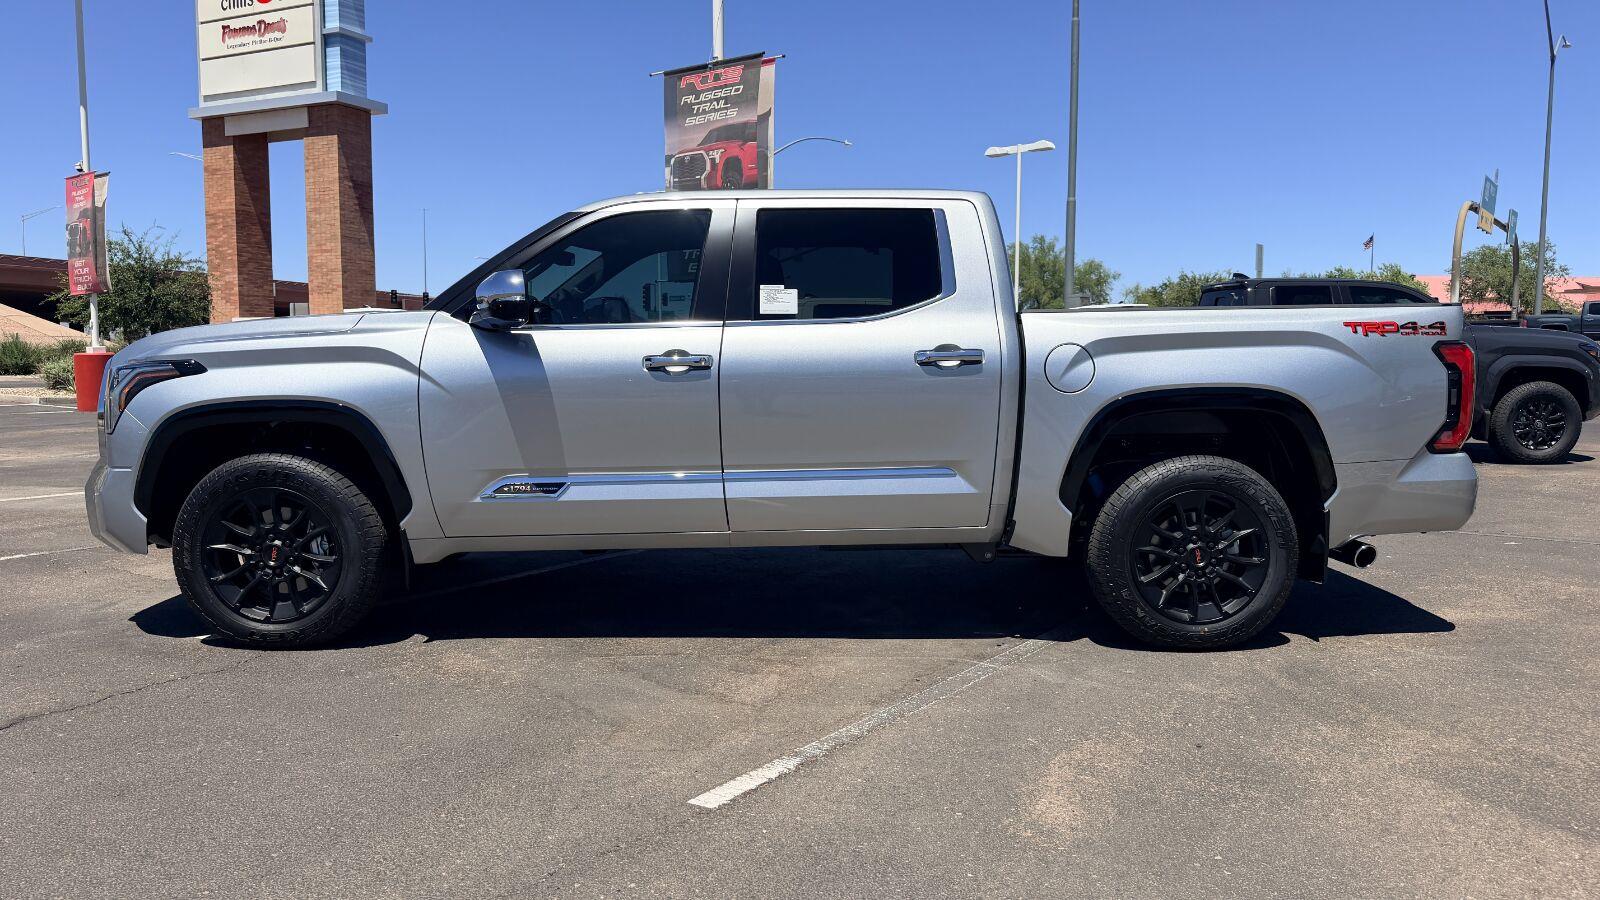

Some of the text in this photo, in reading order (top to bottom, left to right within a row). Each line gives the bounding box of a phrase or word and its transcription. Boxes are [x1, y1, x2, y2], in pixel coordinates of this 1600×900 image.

[680, 65, 744, 91] RTS
[681, 85, 743, 105] RUGGED
[692, 99, 731, 114] TRAIL
[685, 108, 738, 126] SERIES
[73, 267, 90, 275] YOUR
[1343, 321, 1400, 337] TRD
